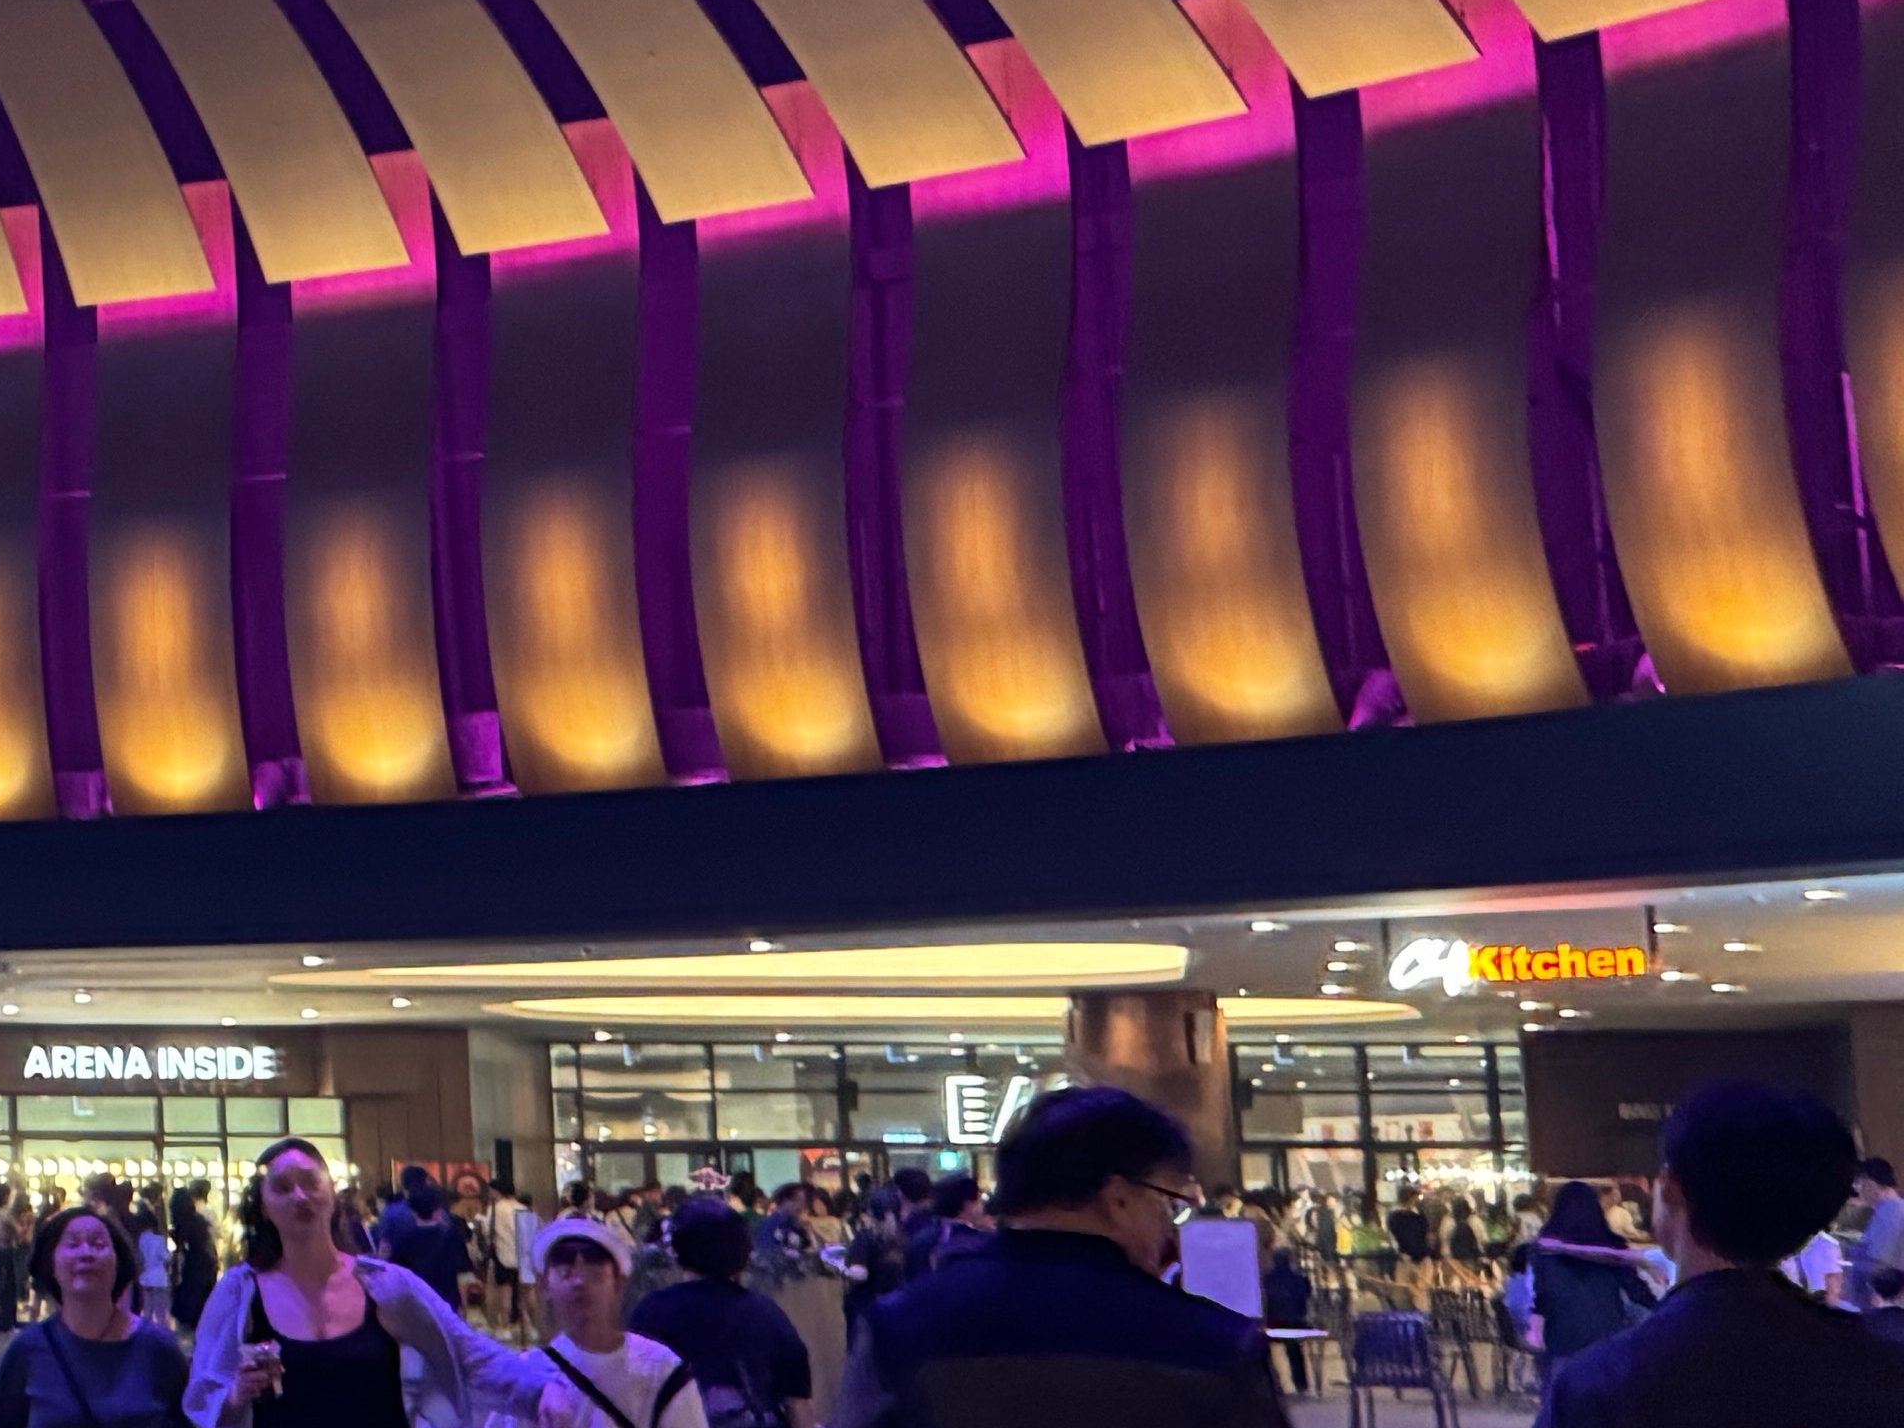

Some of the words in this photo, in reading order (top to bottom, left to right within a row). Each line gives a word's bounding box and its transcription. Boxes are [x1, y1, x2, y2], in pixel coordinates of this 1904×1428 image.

[1469, 941, 1647, 982] Kitchen
[23, 1045, 153, 1080] ARENA
[156, 1046, 277, 1080] INSIDE
